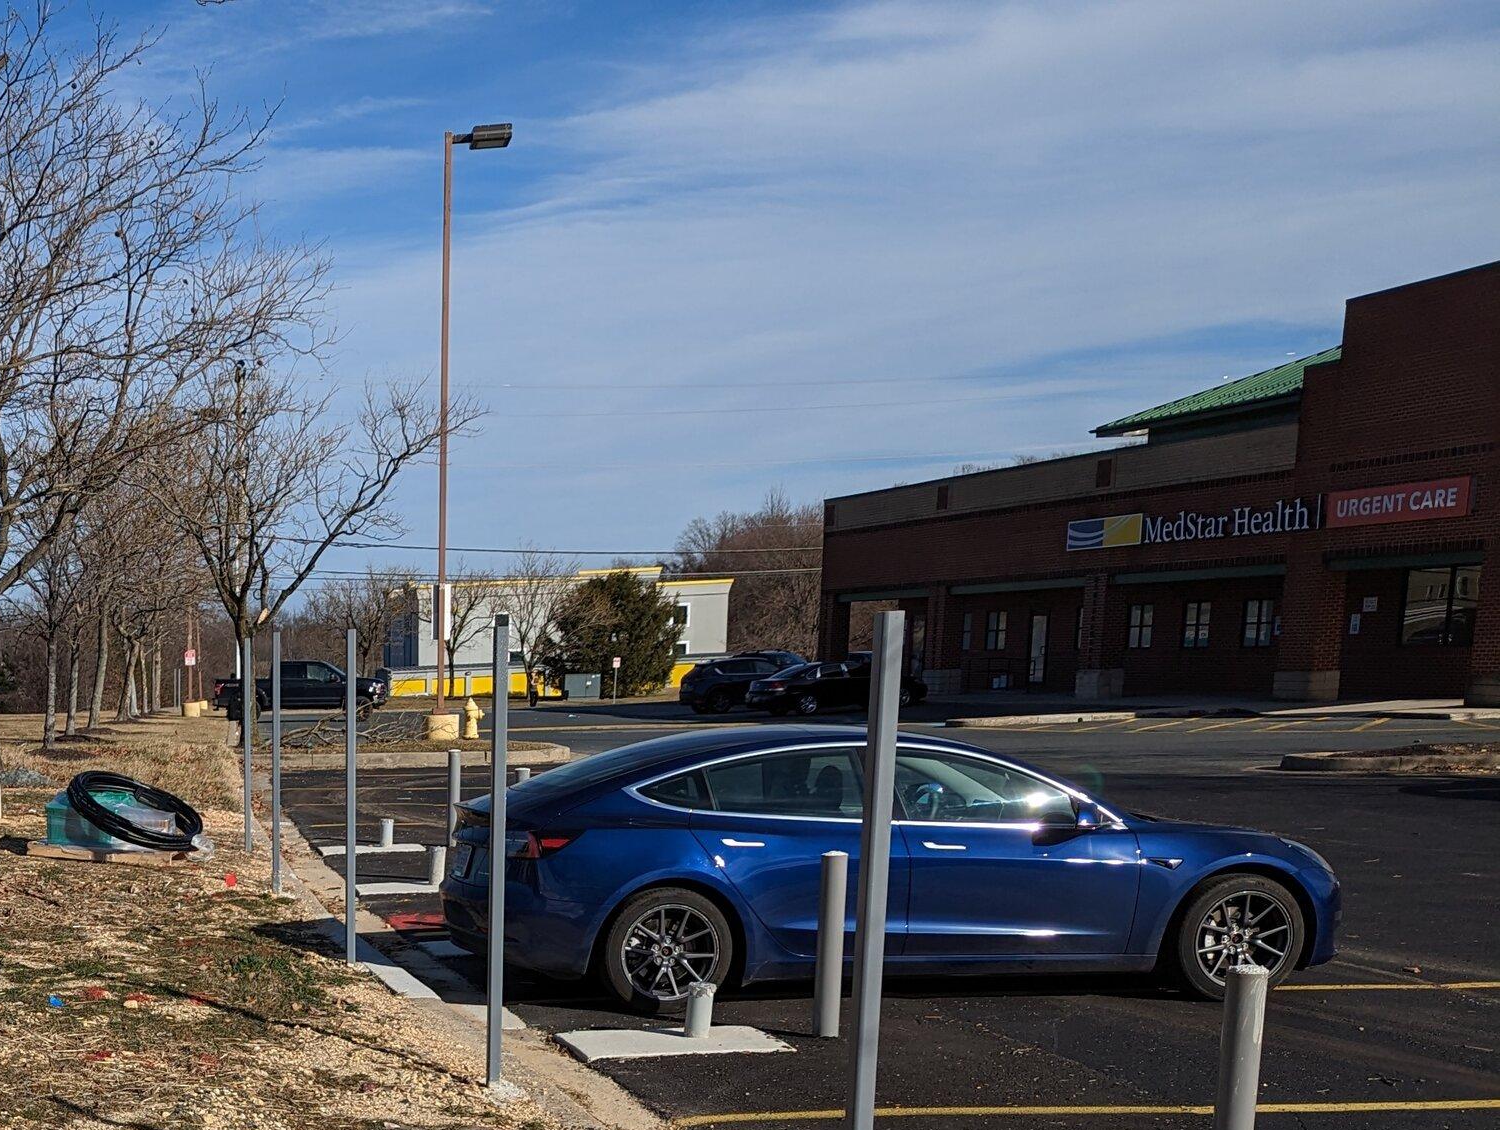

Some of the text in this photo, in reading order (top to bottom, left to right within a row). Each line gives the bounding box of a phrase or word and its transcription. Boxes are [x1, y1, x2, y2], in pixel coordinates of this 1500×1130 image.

[1144, 497, 1309, 544] MedStar Health
[1336, 487, 1458, 519] URGENT CARE
